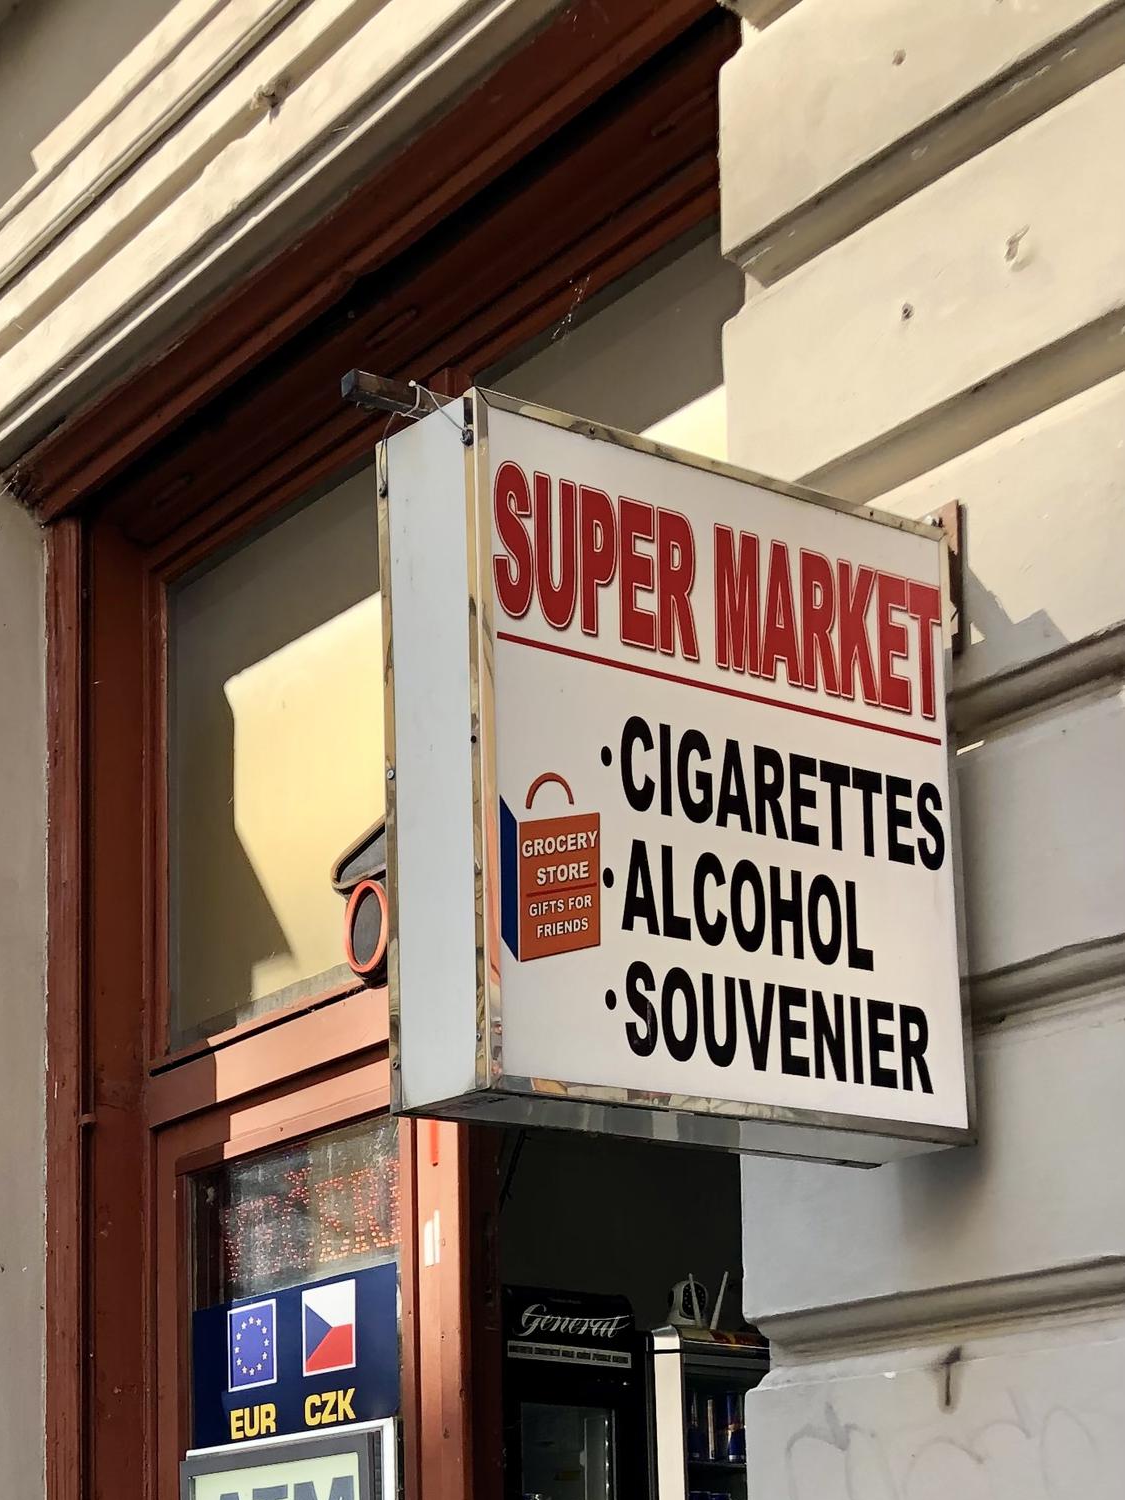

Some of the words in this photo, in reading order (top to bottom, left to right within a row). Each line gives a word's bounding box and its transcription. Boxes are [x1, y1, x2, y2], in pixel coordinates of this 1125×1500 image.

[493, 460, 699, 661] SUPER
[714, 523, 942, 719] MARKET
[619, 715, 945, 871] CIGARETTES
[522, 831, 598, 858] GROCERY
[536, 861, 589, 885] STORE
[529, 899, 565, 917] GIFTS
[568, 894, 592, 911] FOR
[537, 918, 589, 938] FRIENDS
[620, 839, 874, 972] ALCOHOL
[624, 961, 934, 1094] SOUVENIER
[230, 1403, 276, 1441] EUR
[304, 1388, 356, 1428] CZK
